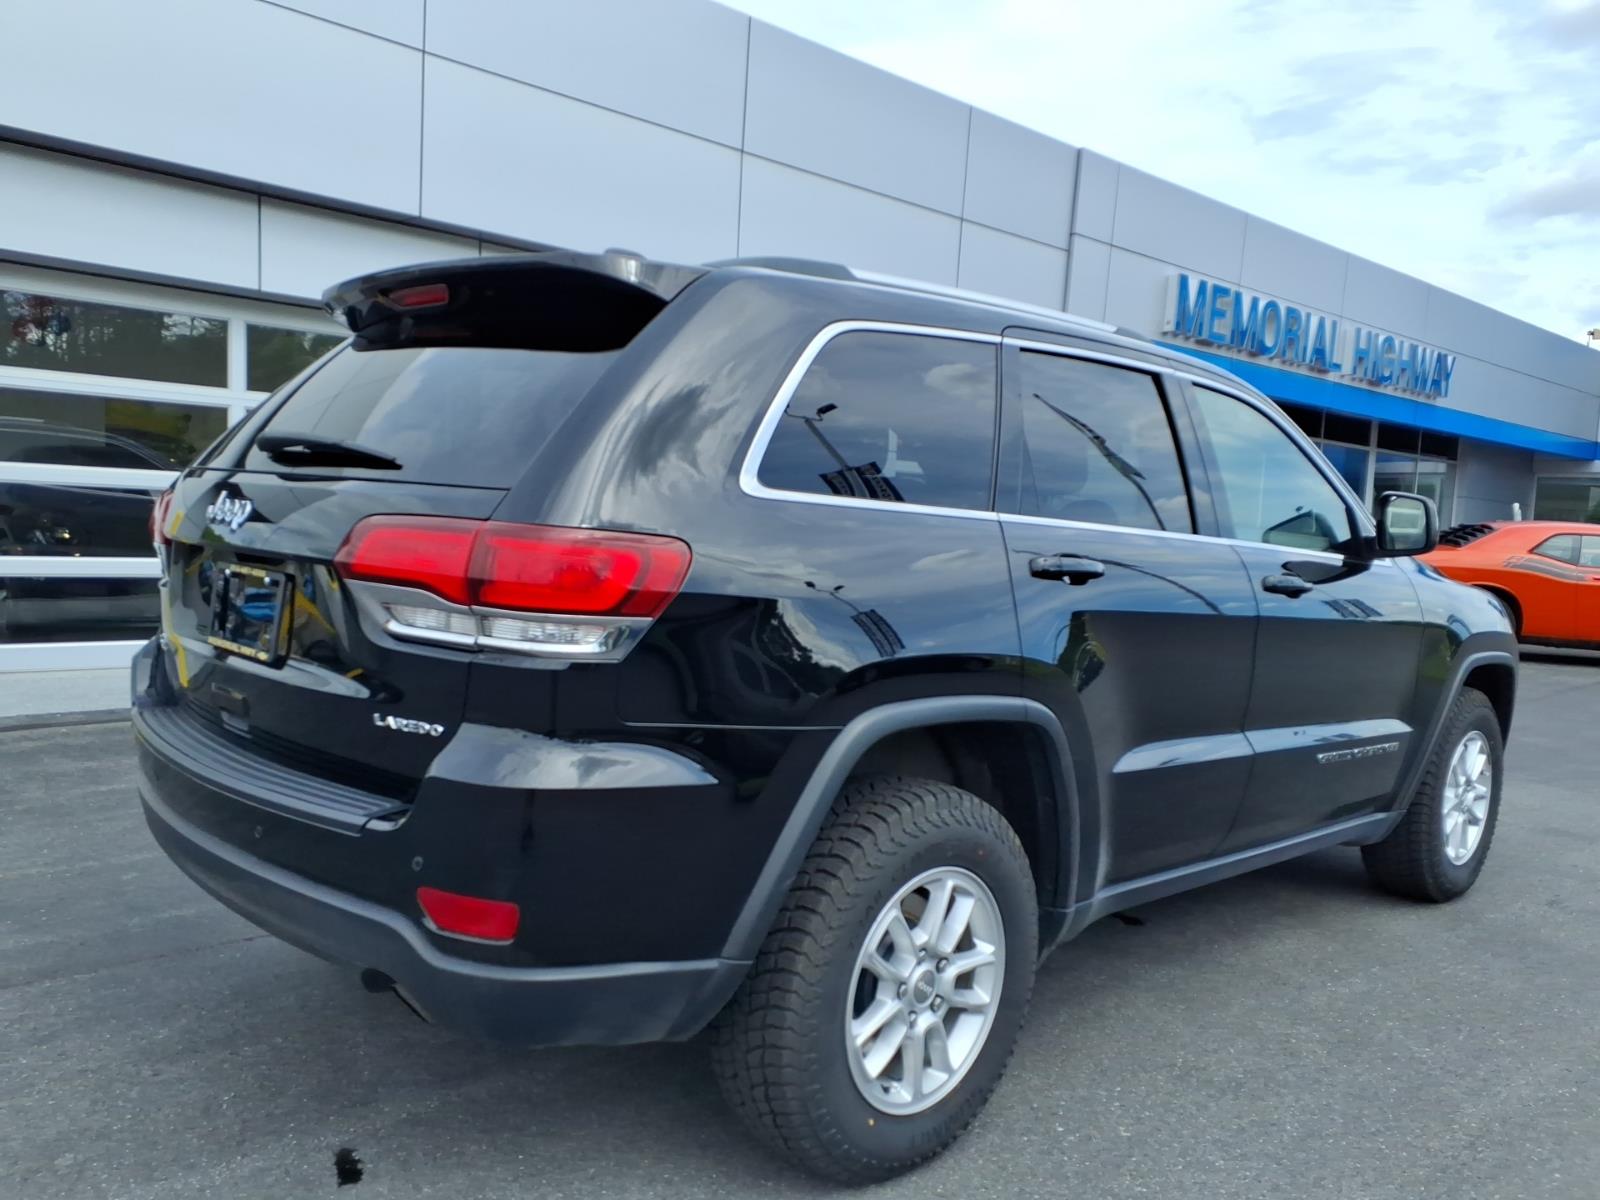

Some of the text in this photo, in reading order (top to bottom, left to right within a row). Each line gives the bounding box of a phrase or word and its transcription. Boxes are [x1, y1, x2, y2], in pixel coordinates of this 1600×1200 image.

[1172, 273, 1457, 397] MEMORIAL HIGHWAY
[205, 489, 253, 530] Jeep
[373, 712, 445, 737] LAREDO
